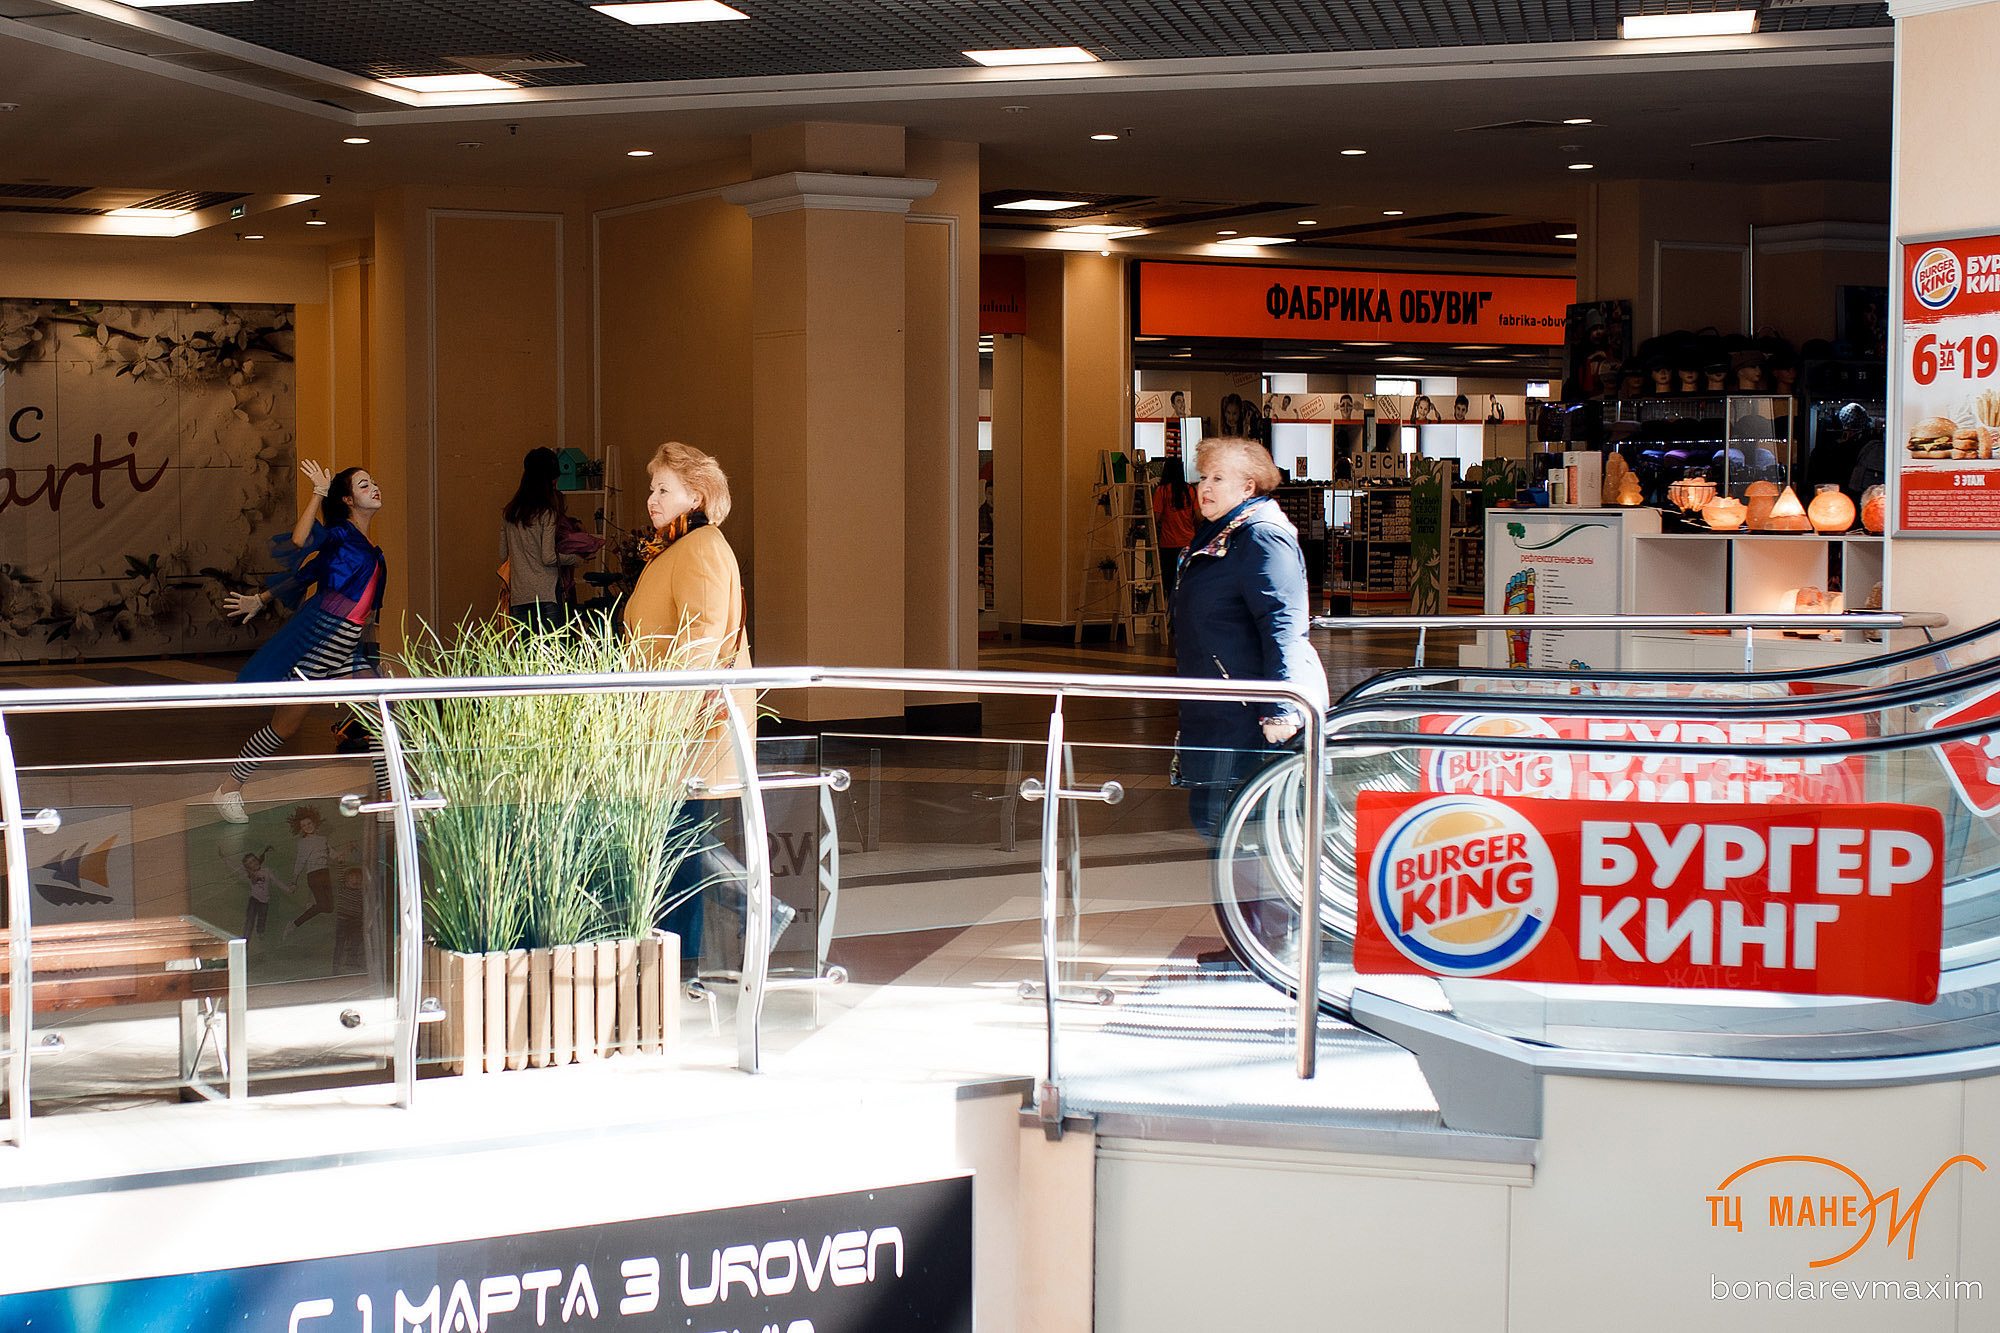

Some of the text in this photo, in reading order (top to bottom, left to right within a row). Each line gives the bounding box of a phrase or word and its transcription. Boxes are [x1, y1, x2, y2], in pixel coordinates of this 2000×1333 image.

[1919, 258, 1955, 282] BURGER
[1921, 268, 1956, 297] KING
[1266, 283, 1393, 323] ФАБРИКА
[1912, 333, 1937, 386] 6
[1961, 474, 1985, 486] ЭТАЖ
[1577, 555, 1594, 565] зоны
[1396, 832, 1528, 890] BURGER
[1580, 820, 1934, 896] БУРГЕР
[1402, 862, 1533, 933] KING
[1579, 895, 1840, 970] КИНГ
[394, 1263, 599, 1333] МАРТА
